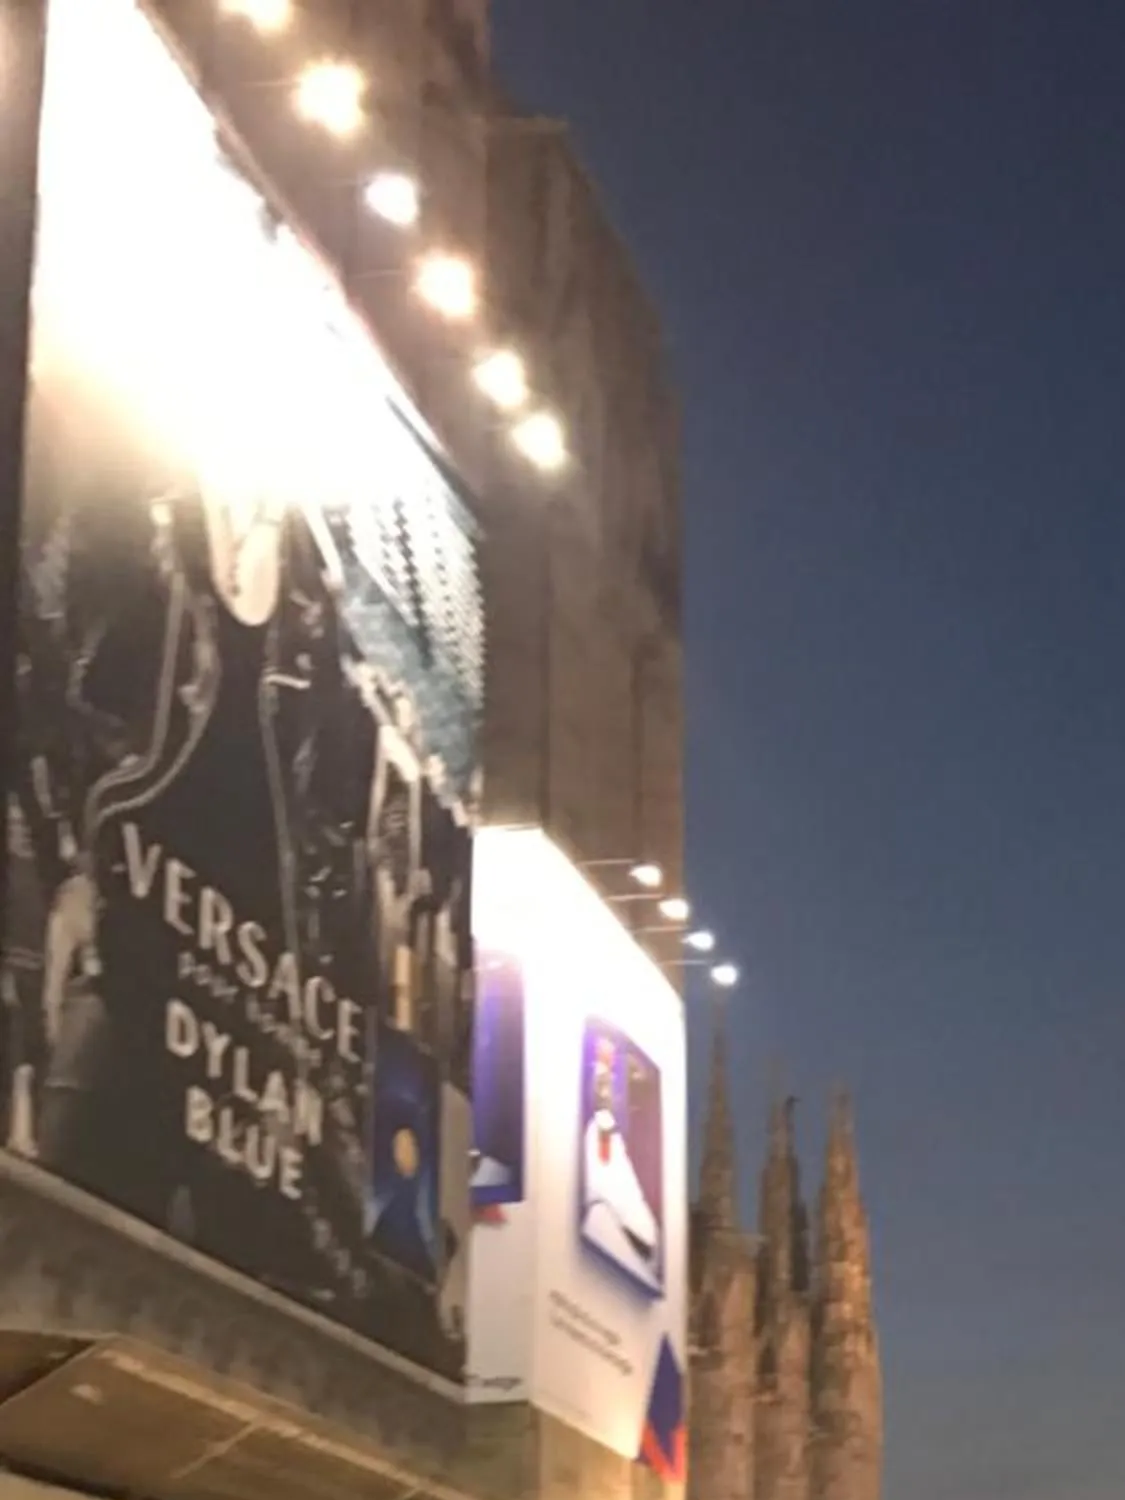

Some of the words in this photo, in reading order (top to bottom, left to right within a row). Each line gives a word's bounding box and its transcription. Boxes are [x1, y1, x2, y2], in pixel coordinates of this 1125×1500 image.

[122, 821, 363, 1064] VERSACE
[165, 998, 324, 1146] DYLAN
[185, 1084, 303, 1200] BLUE
